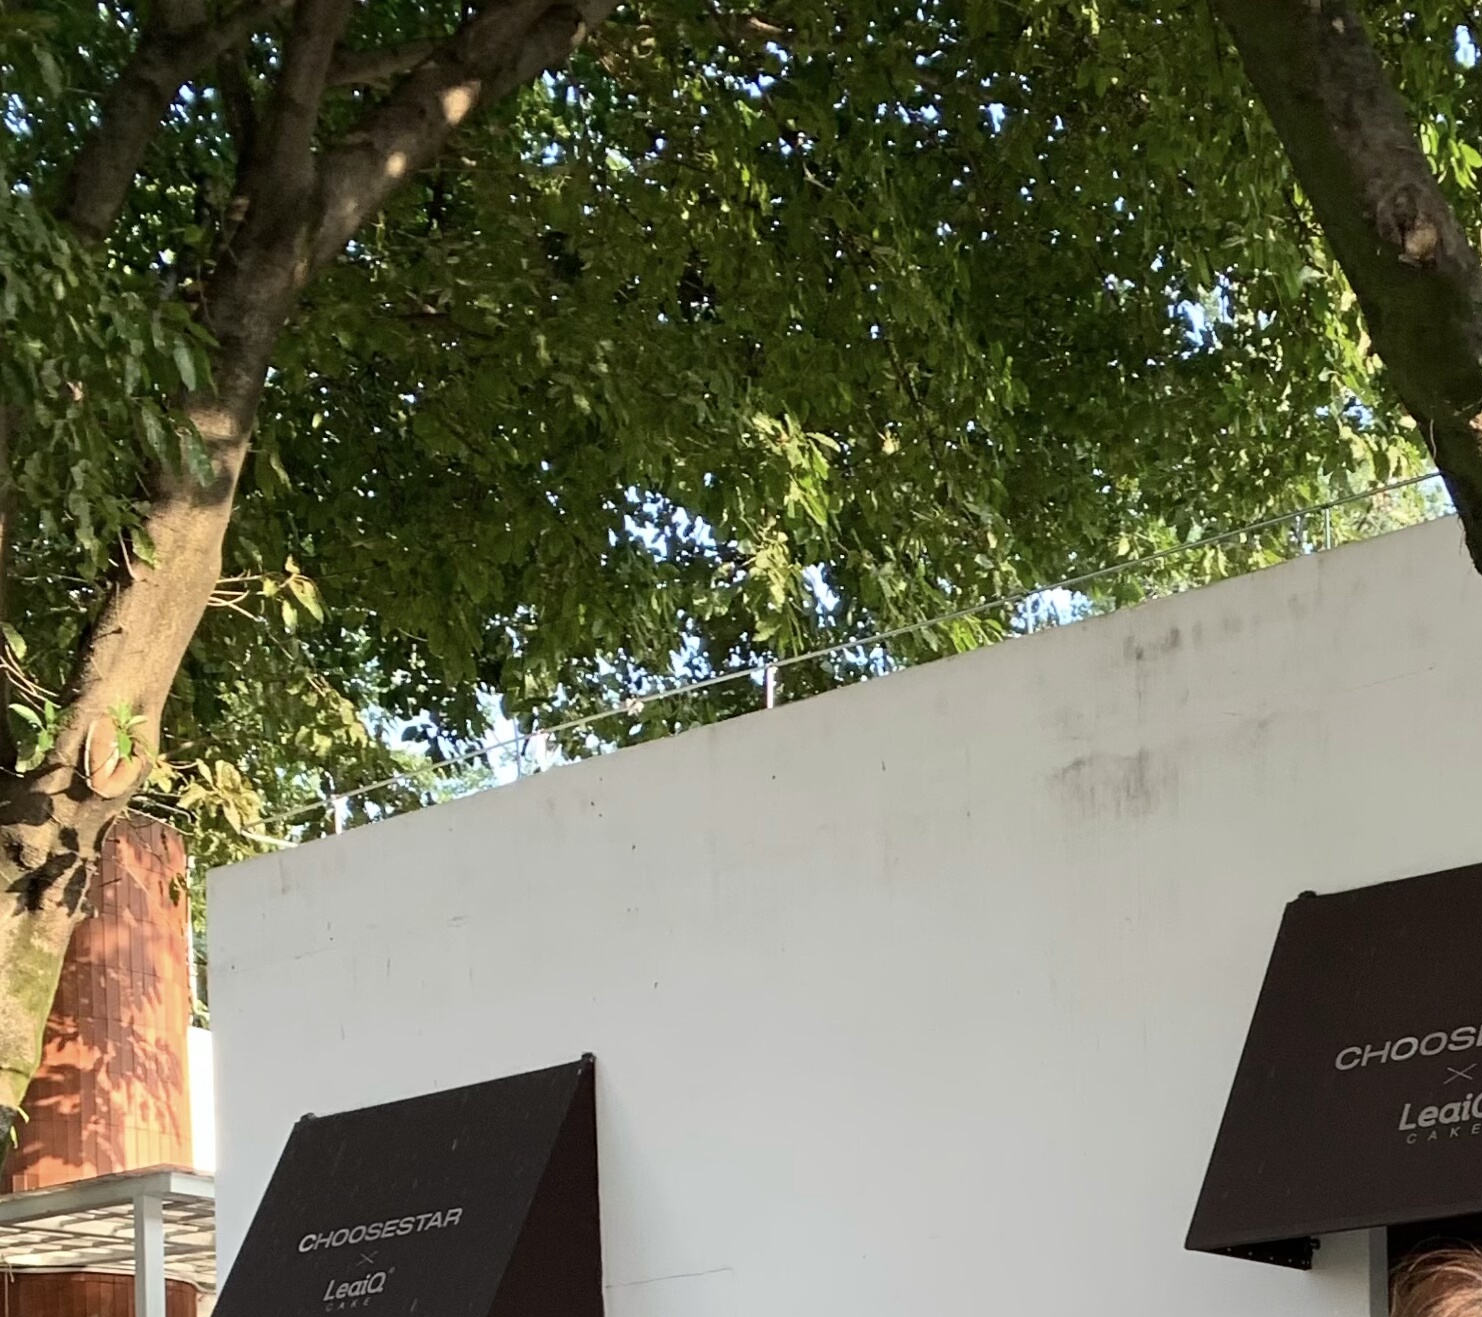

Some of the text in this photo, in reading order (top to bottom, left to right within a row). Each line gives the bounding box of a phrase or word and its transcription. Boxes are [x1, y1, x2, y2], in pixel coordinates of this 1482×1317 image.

[1405, 1123, 1482, 1145] CAKE
[298, 1207, 464, 1253] CHOOSESTAR
[324, 1296, 372, 1313] CAKE
